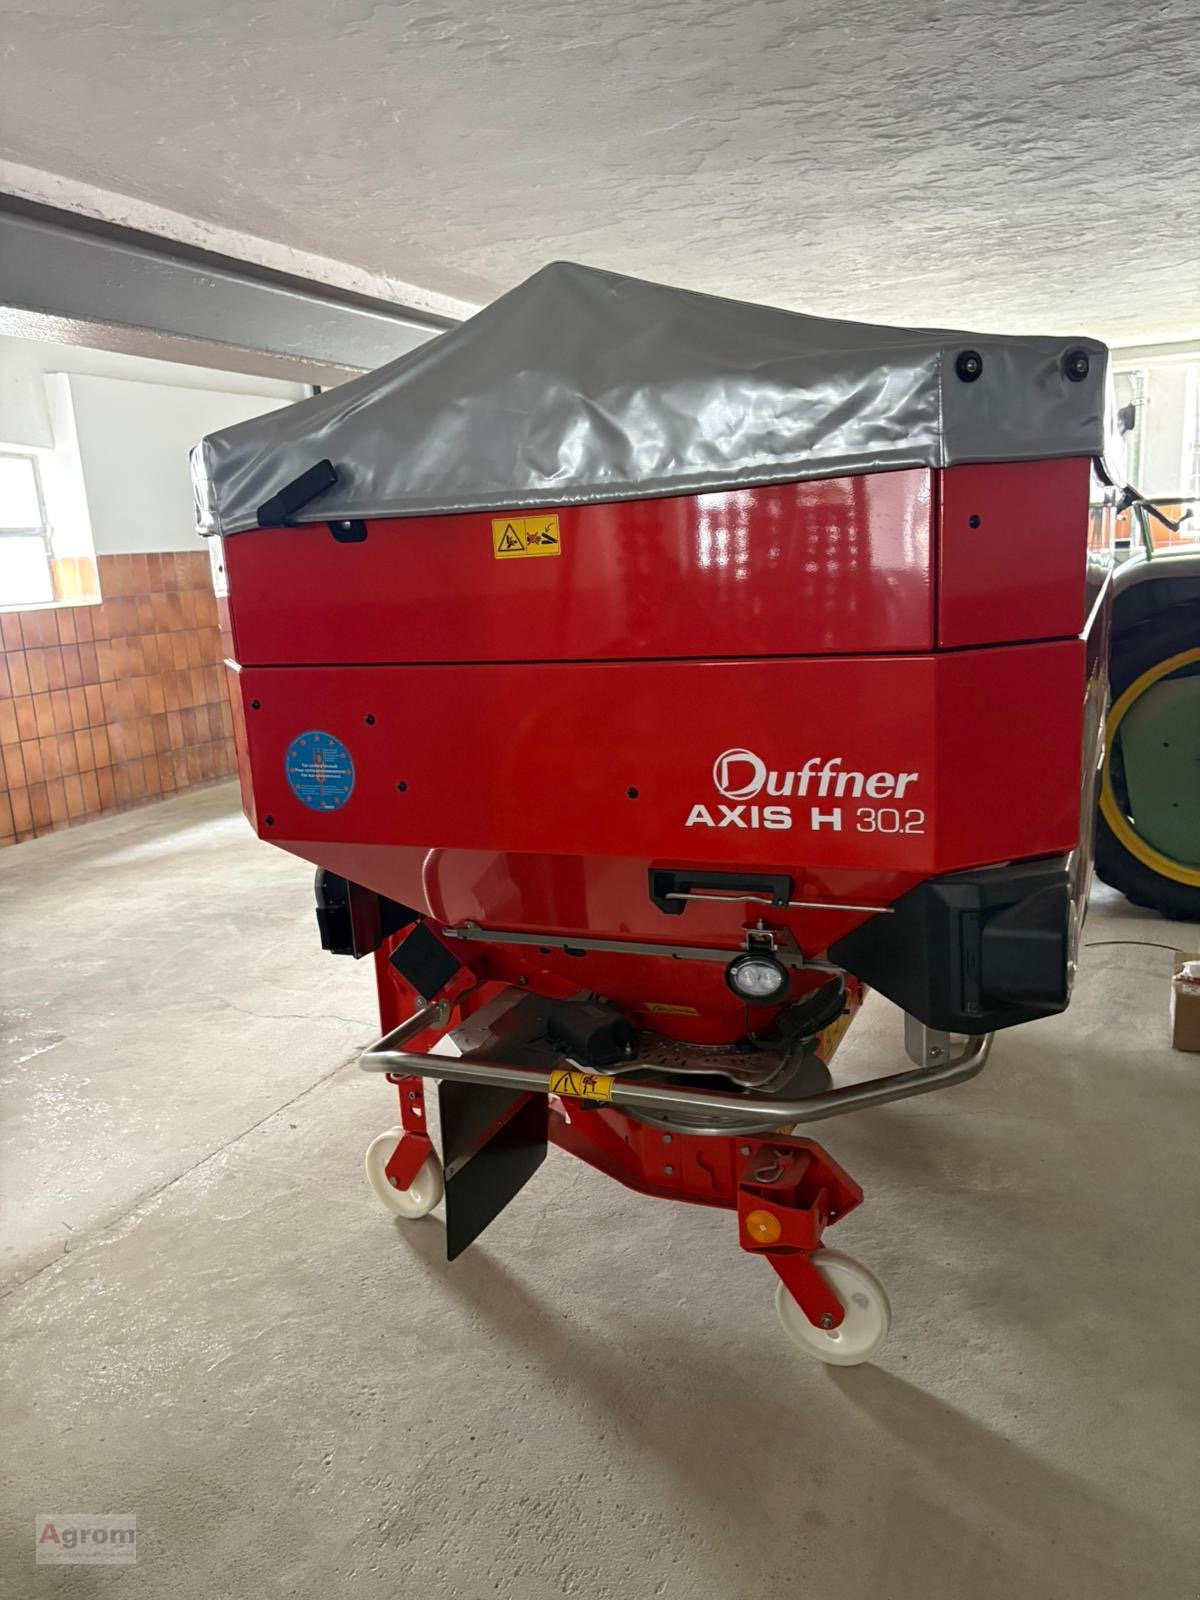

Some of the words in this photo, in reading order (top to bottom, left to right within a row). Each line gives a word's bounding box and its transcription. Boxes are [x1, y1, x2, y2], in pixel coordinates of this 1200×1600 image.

[713, 748, 919, 800] Duffner
[685, 804, 792, 829] AXIS
[811, 807, 842, 831] H
[856, 808, 925, 834] 30.2
